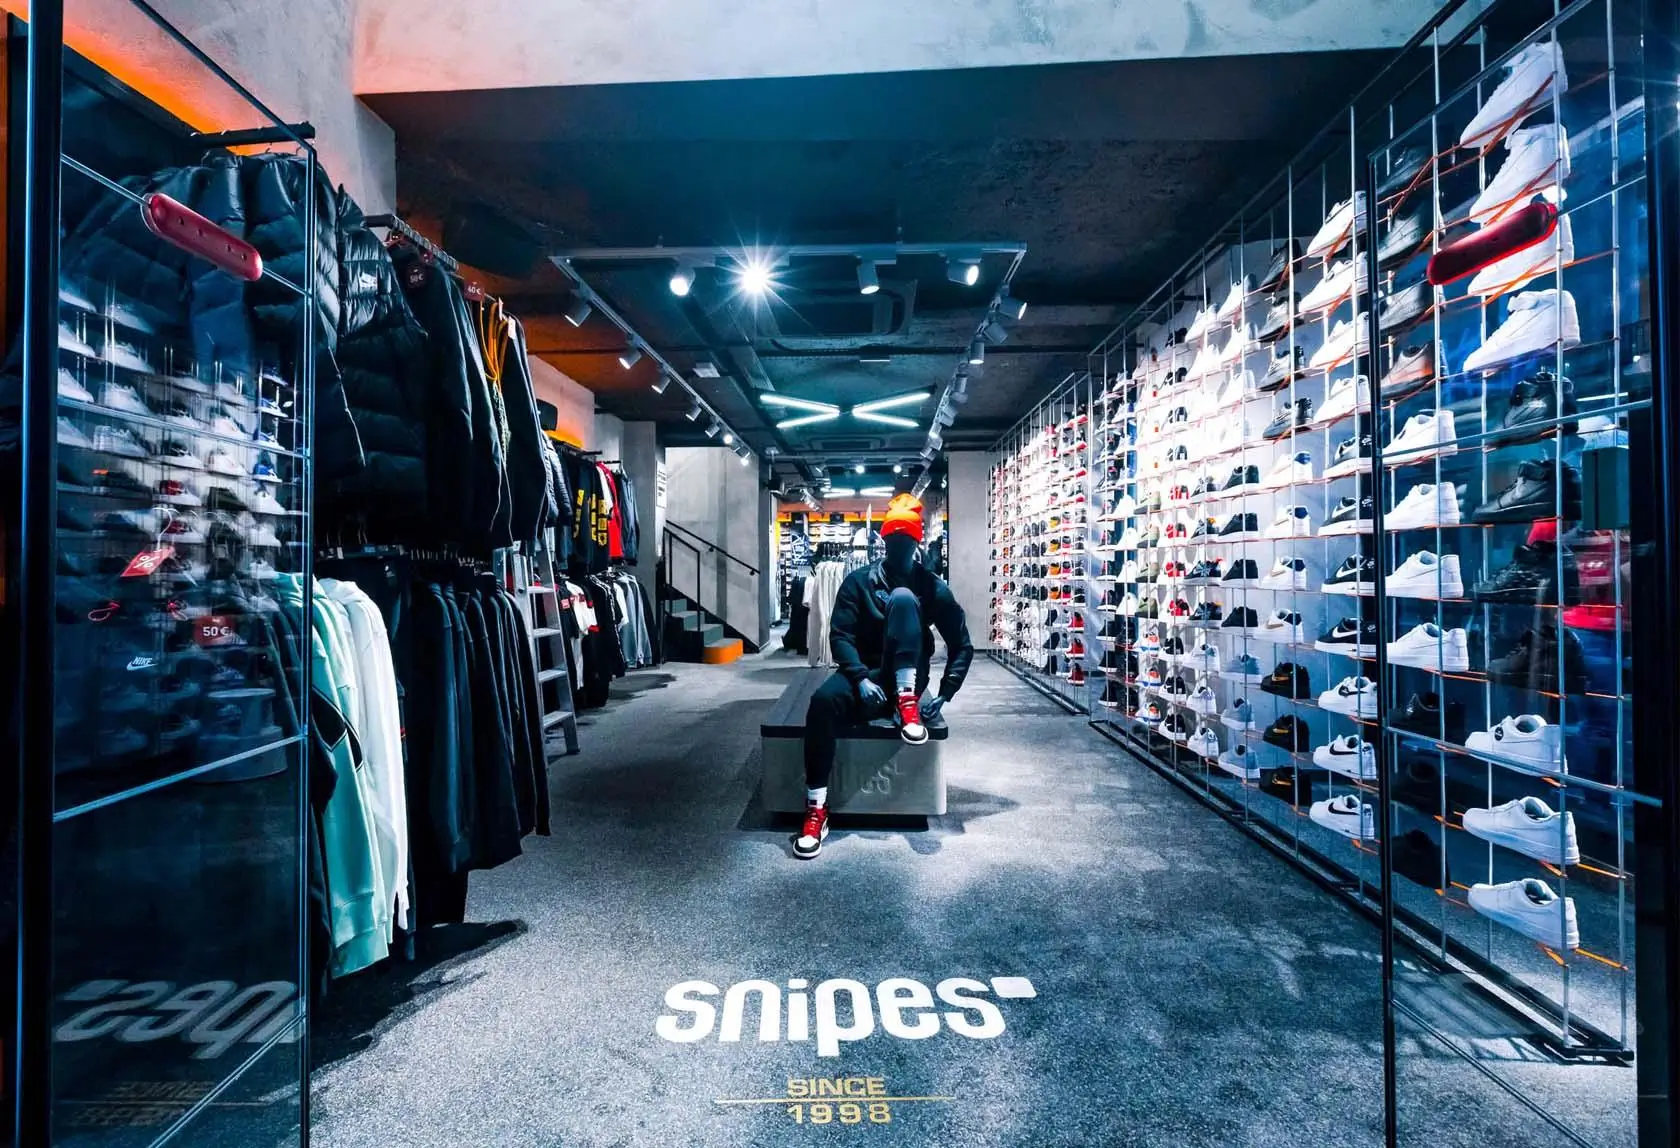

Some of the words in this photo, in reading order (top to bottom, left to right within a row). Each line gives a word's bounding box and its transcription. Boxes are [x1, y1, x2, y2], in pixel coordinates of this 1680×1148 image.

[656, 976, 1006, 1056] snipes
[787, 1077, 887, 1097] SINCE
[787, 1103, 892, 1125] 1998
